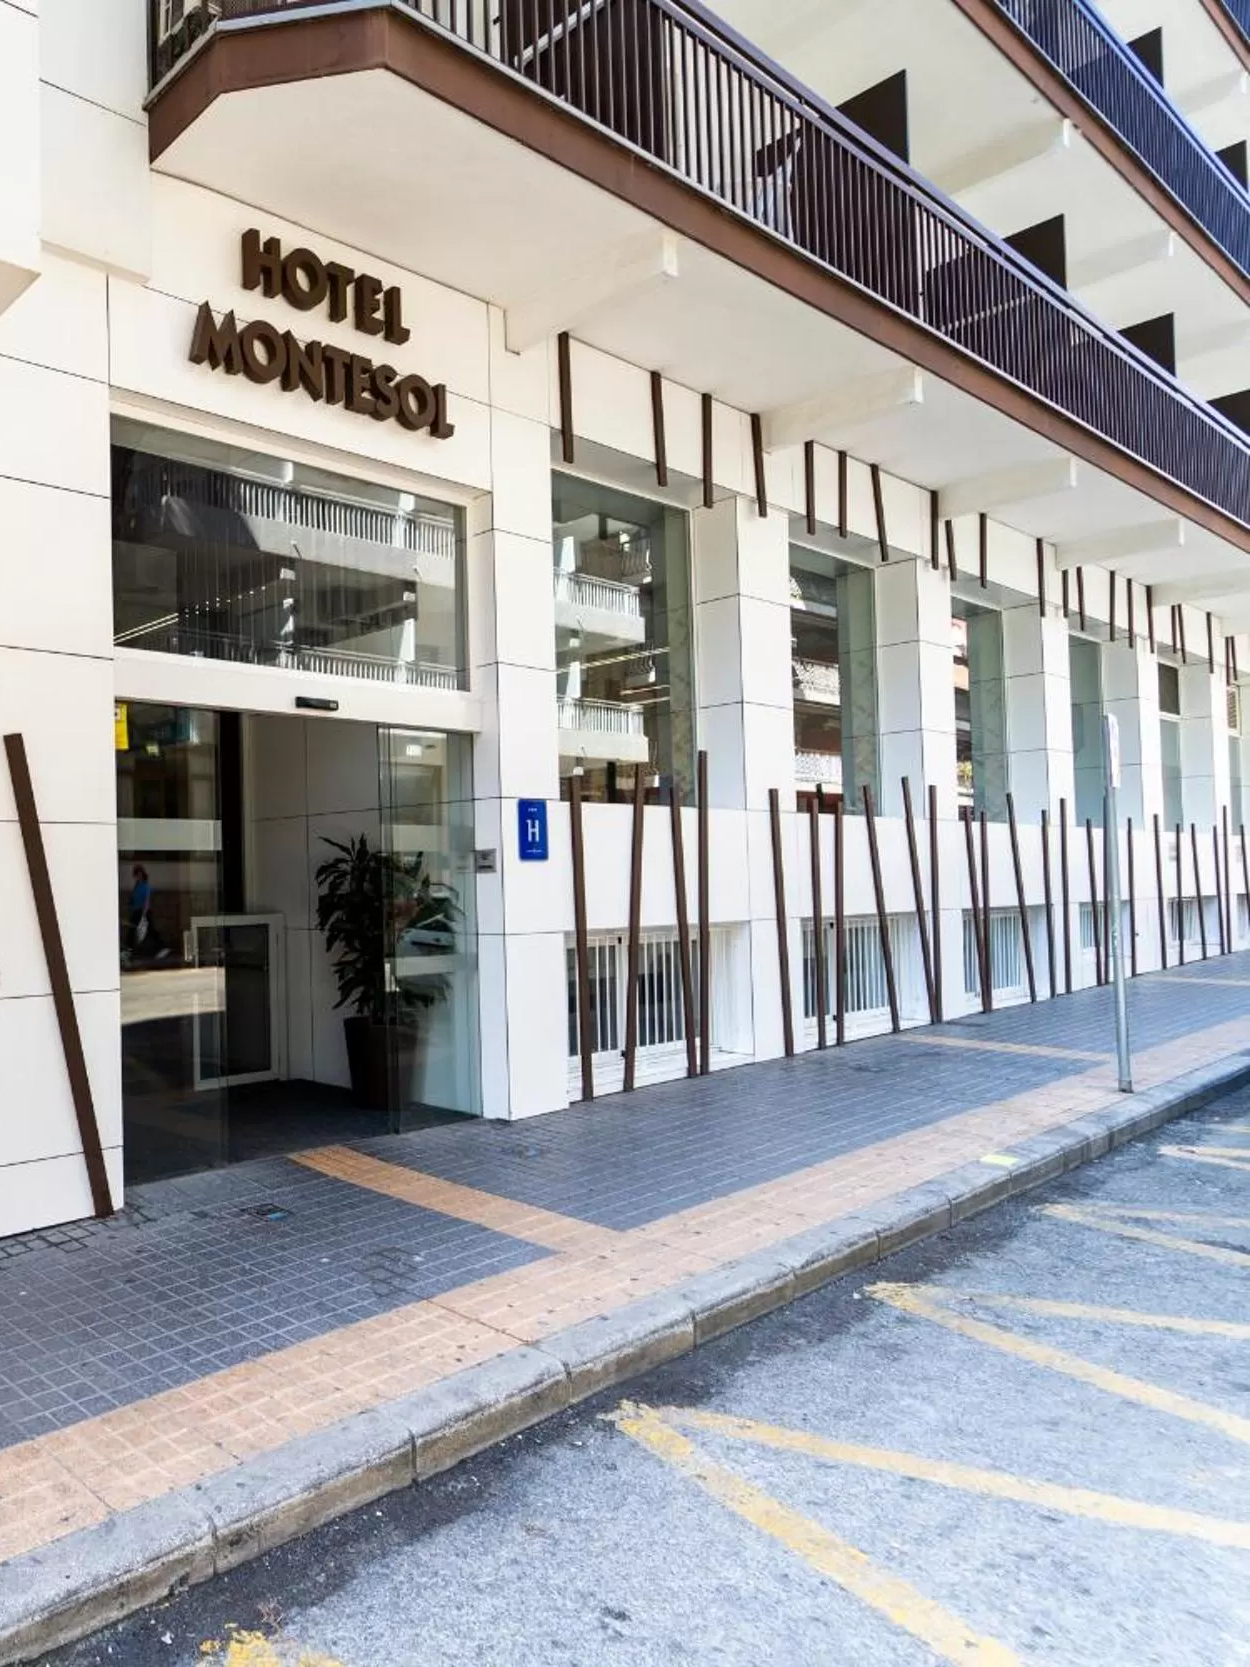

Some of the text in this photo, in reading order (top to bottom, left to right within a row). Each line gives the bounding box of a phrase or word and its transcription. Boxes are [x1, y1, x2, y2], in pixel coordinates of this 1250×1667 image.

[241, 227, 411, 346] HOTEL
[188, 300, 455, 440] MONTESOL
[526, 818, 540, 843] H
